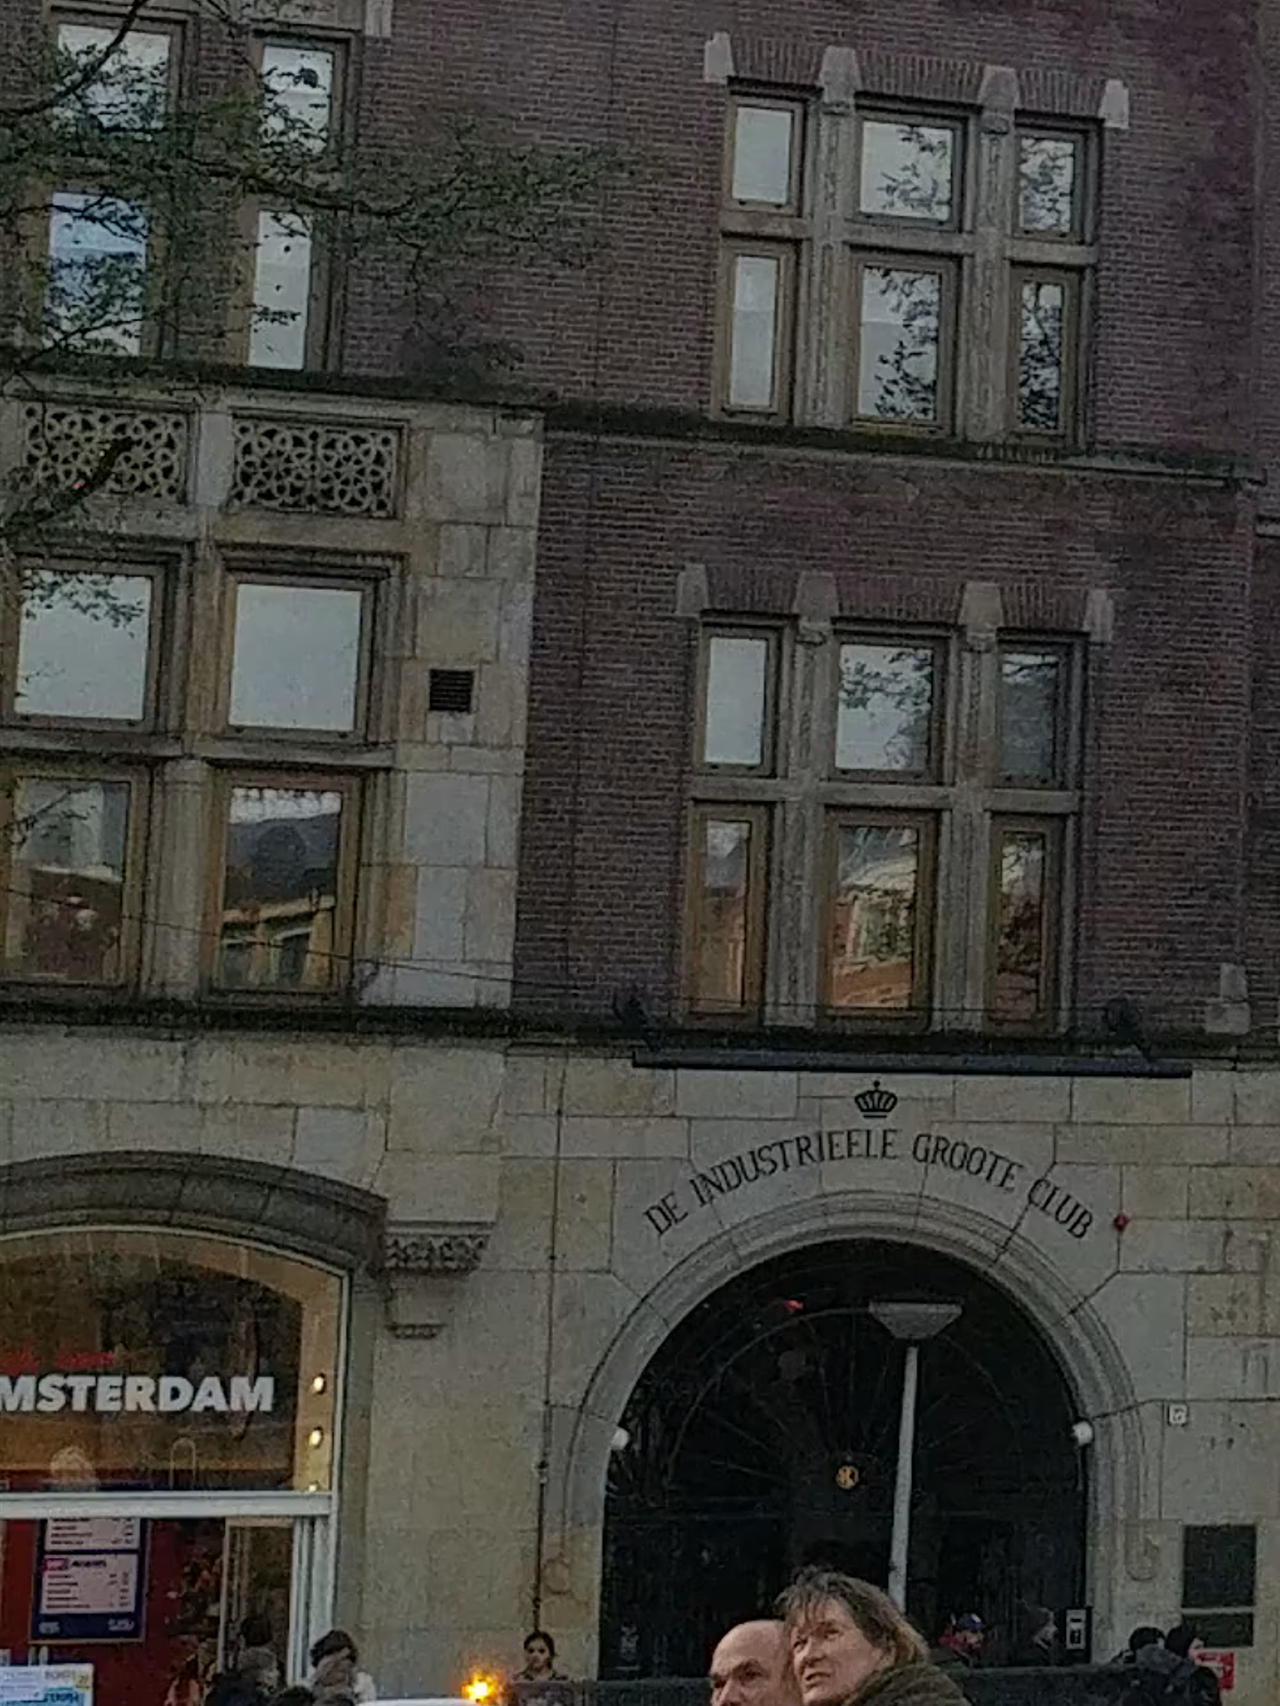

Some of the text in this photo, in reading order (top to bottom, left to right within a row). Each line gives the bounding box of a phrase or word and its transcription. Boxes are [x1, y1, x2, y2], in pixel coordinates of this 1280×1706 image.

[643, 1128, 1094, 1240] DE INDUSTRIEELE GROOTE CLUB
